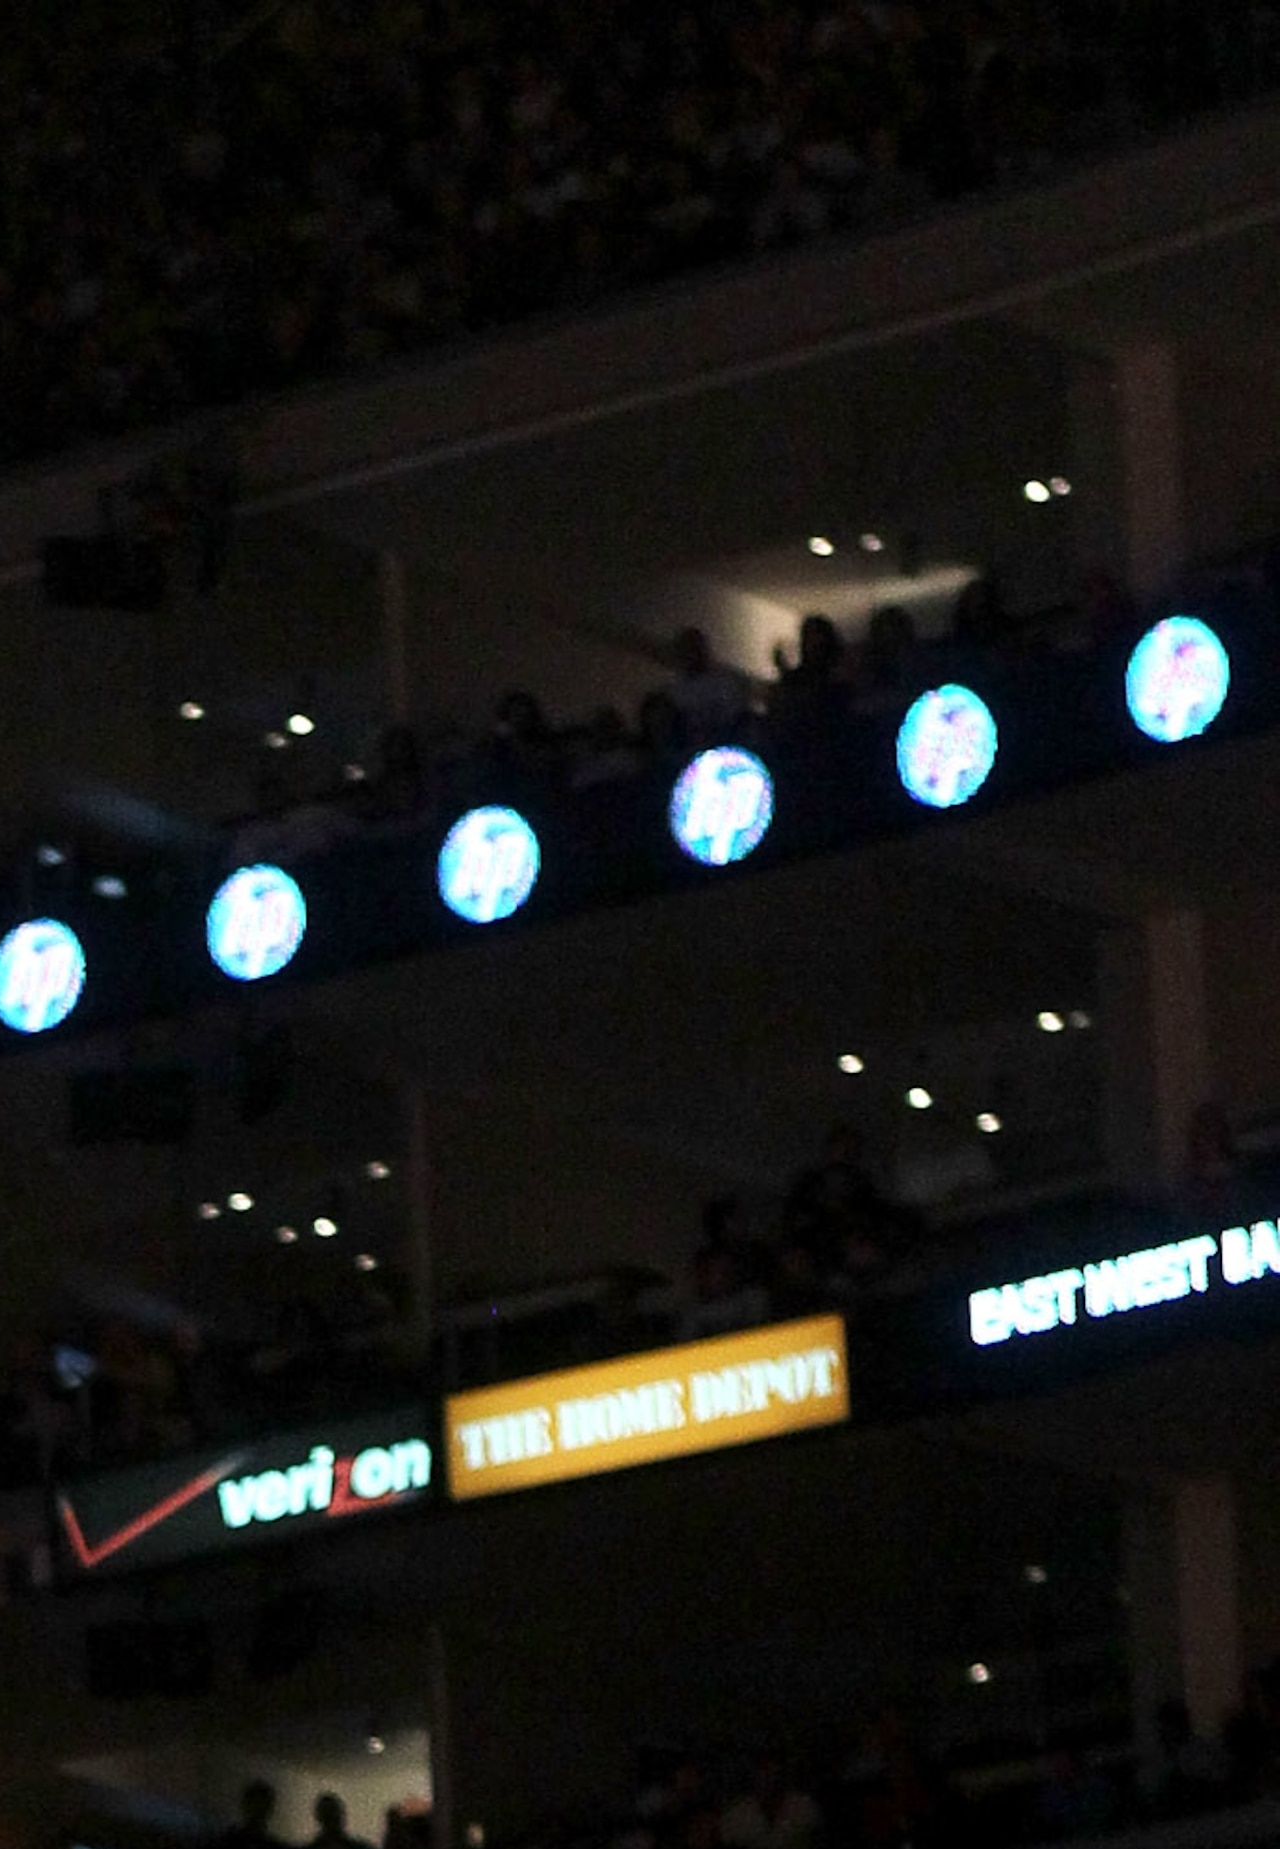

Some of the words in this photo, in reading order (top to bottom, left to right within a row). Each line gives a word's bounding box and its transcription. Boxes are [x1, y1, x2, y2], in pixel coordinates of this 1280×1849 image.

[969, 1267, 1085, 1345] EAST
[1083, 1234, 1218, 1318] WEST
[456, 1406, 553, 1471] THE
[555, 1379, 687, 1451] HOME
[688, 1346, 840, 1423] DEPOT
[218, 1438, 433, 1529] verizon
